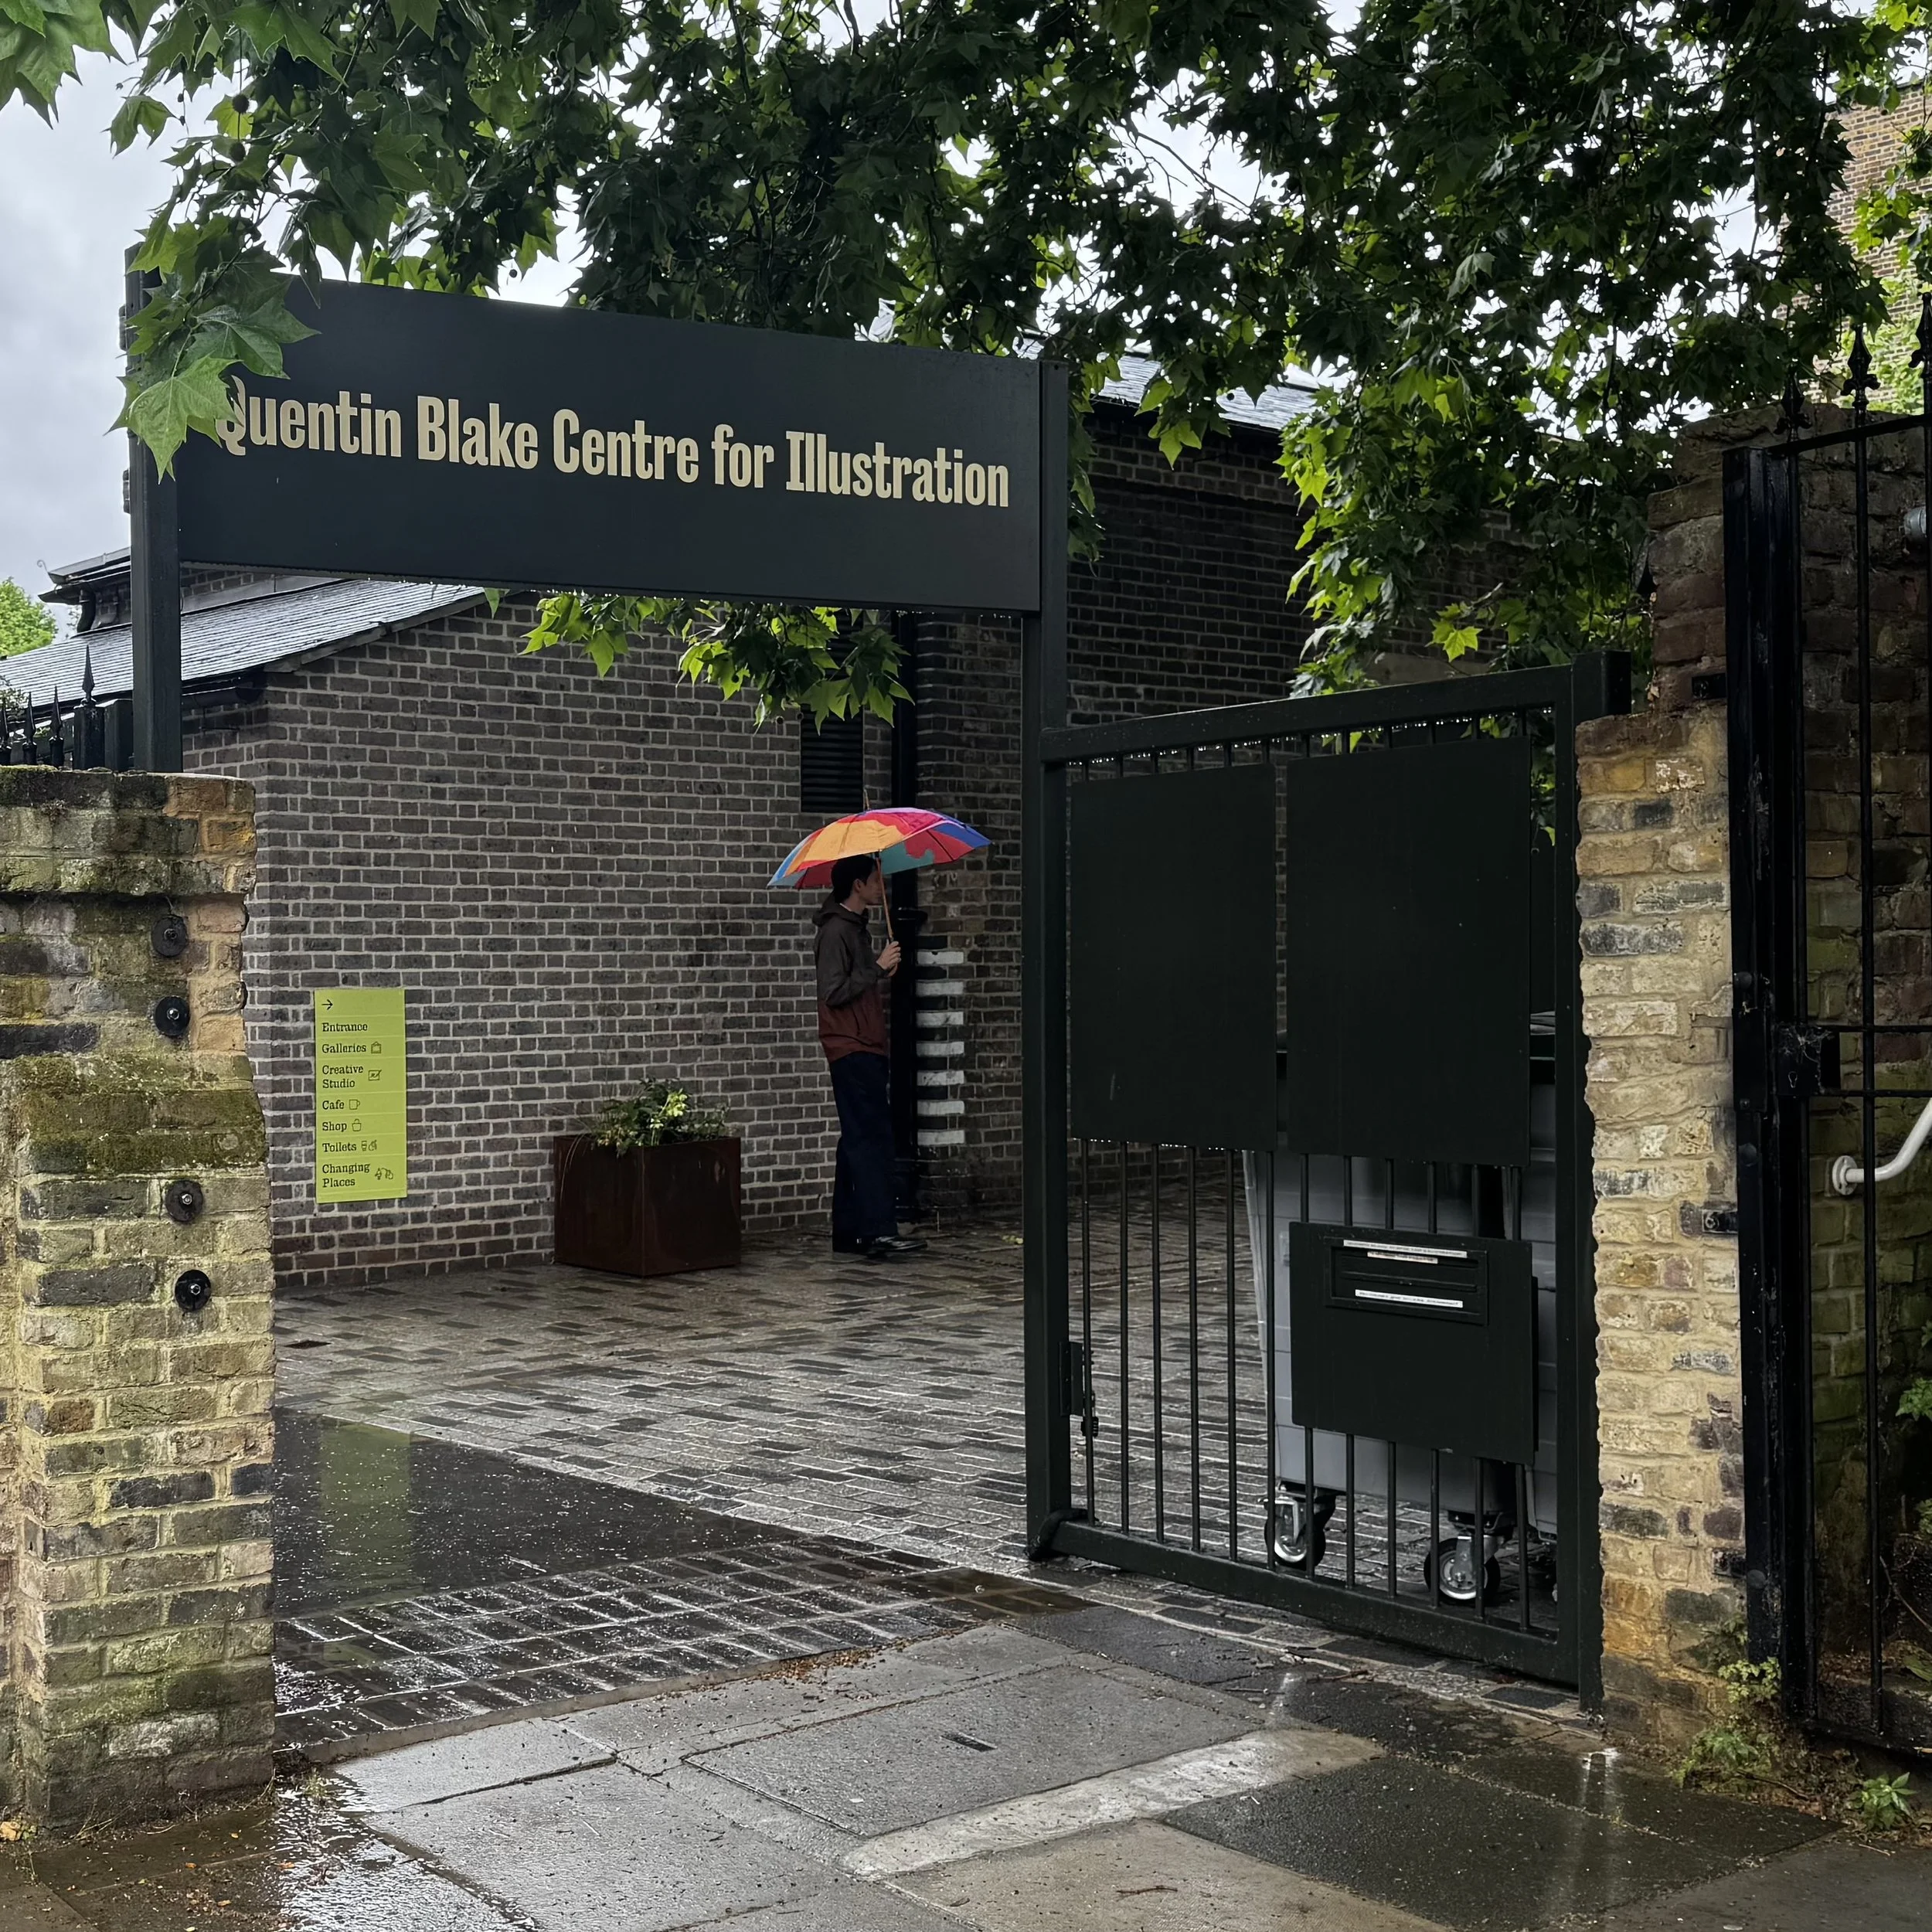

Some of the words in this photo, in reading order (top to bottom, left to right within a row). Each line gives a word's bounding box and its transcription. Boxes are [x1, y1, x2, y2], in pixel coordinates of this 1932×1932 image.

[216, 375, 402, 456] Quentin
[417, 395, 539, 470] Blake
[553, 408, 699, 484] Centre
[712, 423, 774, 488] for
[785, 430, 1009, 508] Illustration
[321, 1022, 368, 1032] Entrance
[321, 1043, 367, 1053] Galleries
[321, 1064, 364, 1075] Creative
[321, 1078, 355, 1089] Studio
[321, 1099, 345, 1111] Cafe
[321, 1121, 347, 1133] Shop
[321, 1141, 357, 1153] Toilets
[321, 1162, 371, 1175] Changing
[321, 1177, 356, 1189] Places
